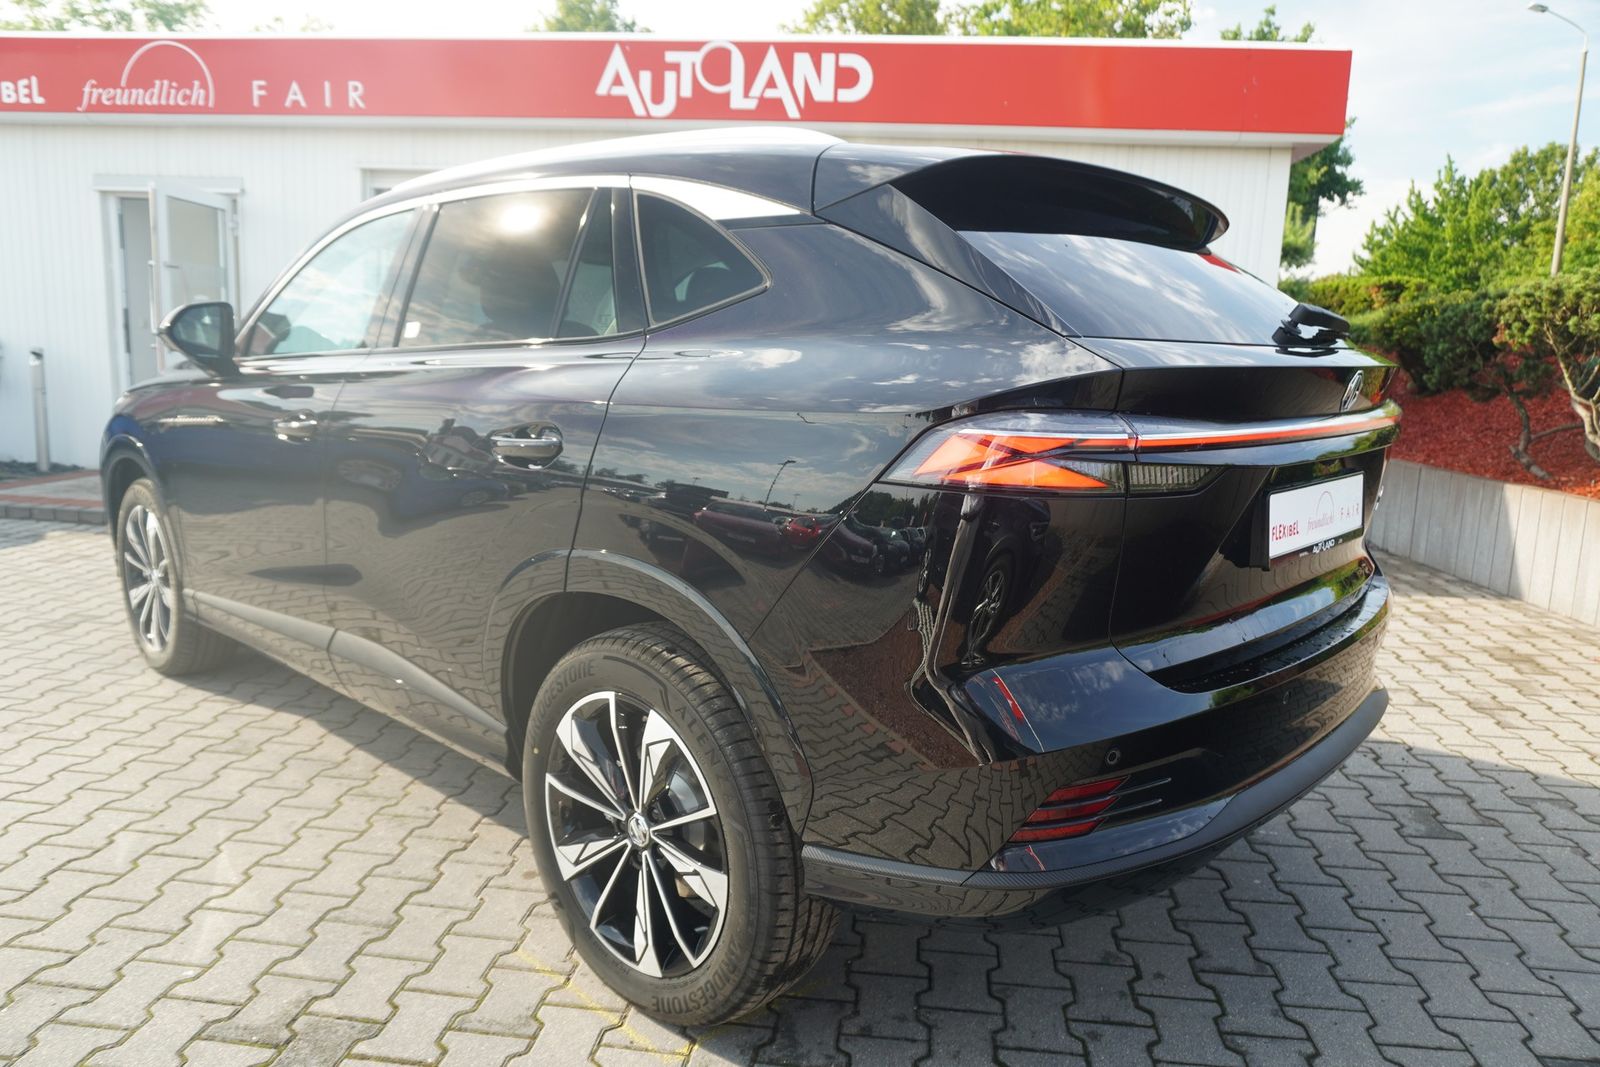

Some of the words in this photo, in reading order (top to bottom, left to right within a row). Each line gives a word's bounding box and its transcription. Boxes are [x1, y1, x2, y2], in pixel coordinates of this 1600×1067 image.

[0, 75, 46, 105] BEL
[76, 78, 206, 112] freundlich
[252, 79, 367, 109] FAIR
[595, 40, 874, 119] AUTOLAND
[1272, 519, 1299, 541] FLEXIBEL
